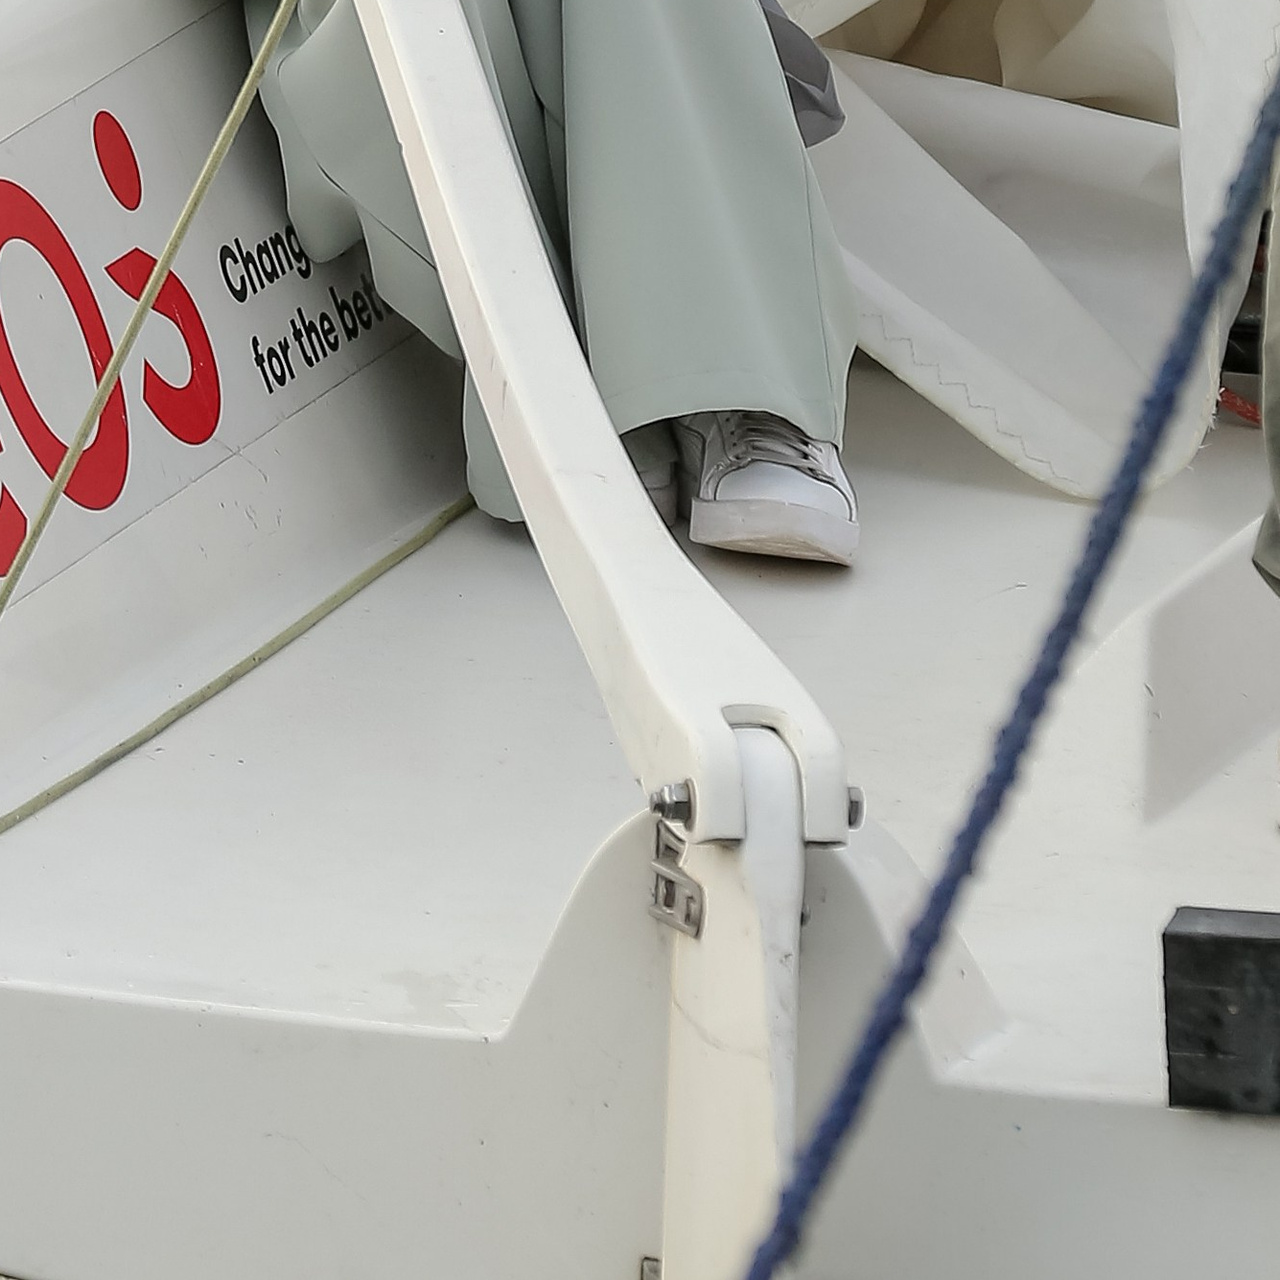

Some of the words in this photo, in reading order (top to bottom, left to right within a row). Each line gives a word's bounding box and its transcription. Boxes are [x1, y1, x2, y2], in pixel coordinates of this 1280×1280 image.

[251, 335, 296, 395] for
[290, 307, 340, 369] the
[328, 273, 394, 342] bet
